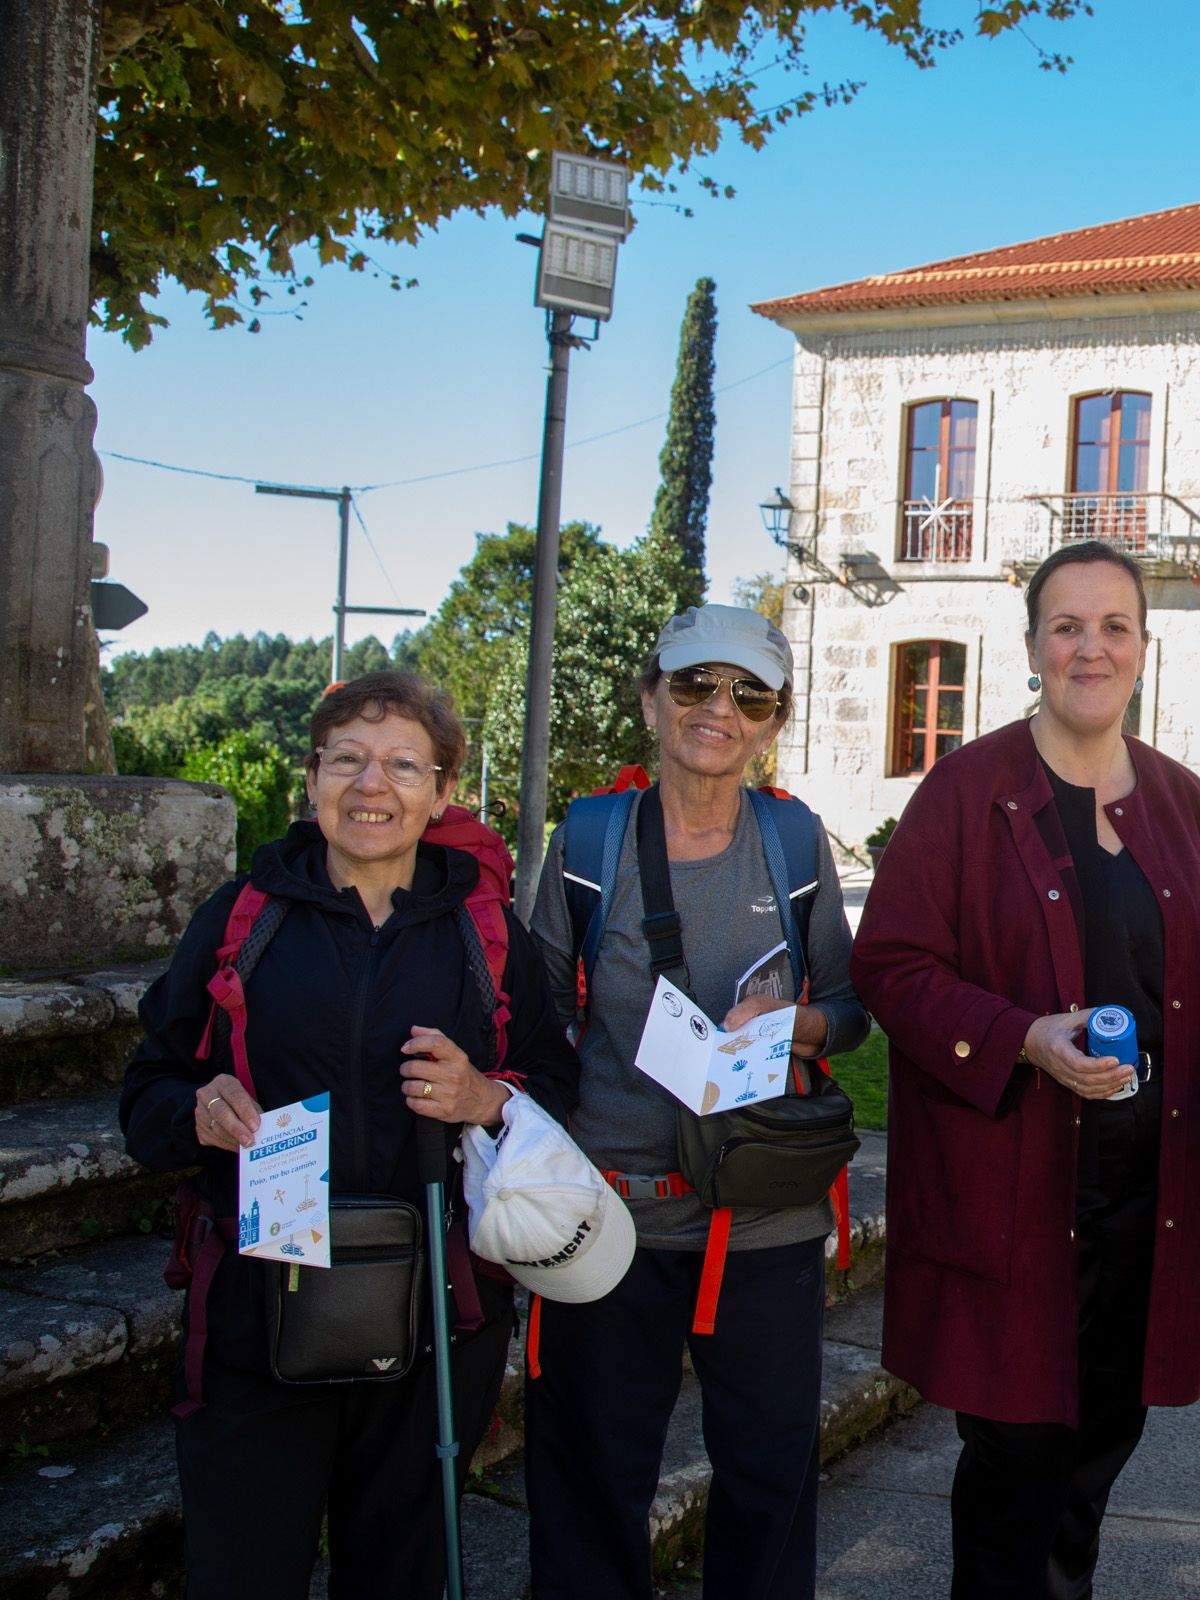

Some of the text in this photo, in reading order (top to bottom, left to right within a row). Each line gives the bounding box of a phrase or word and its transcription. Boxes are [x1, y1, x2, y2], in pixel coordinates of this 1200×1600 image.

[751, 905, 776, 913] Topper
[260, 1125, 305, 1145] CREDENCIAL
[251, 1131, 315, 1160] PEREGRINO
[269, 1172, 280, 1181] no
[280, 1169, 290, 1177] bo
